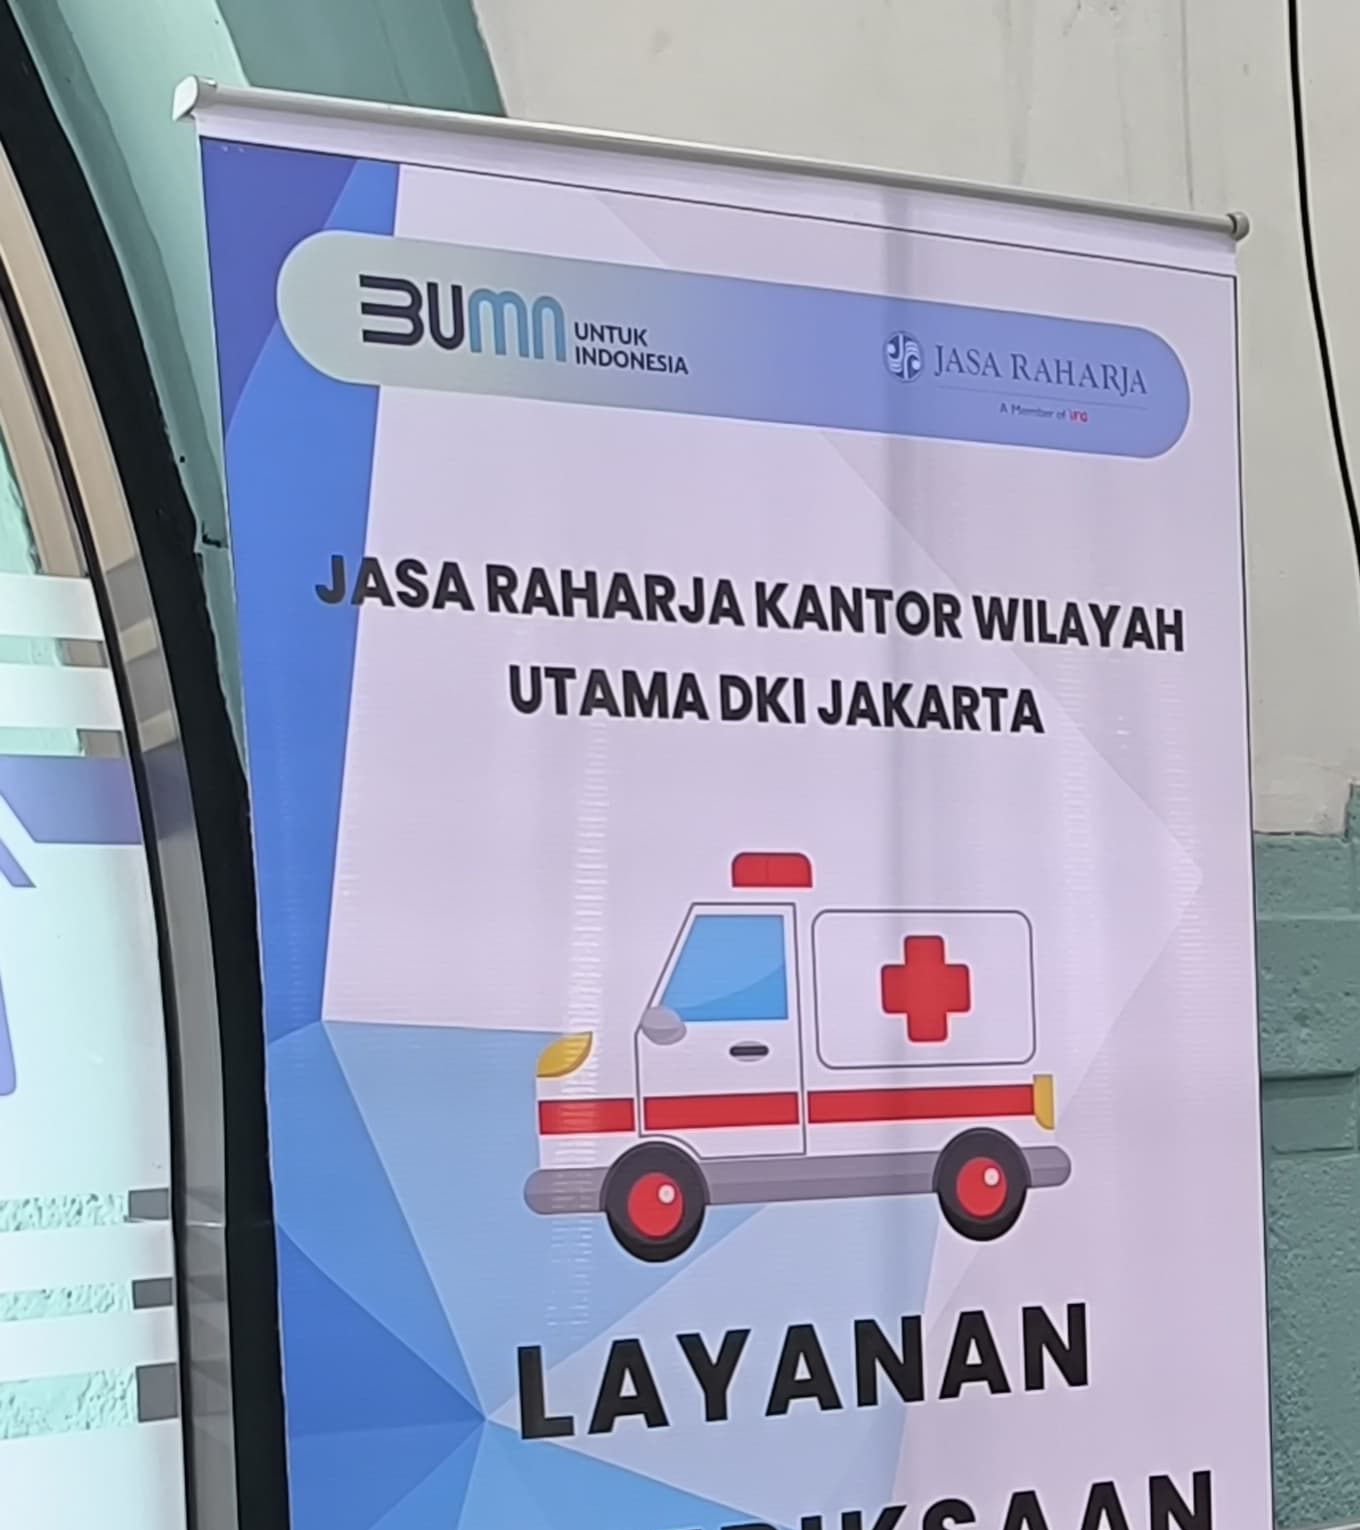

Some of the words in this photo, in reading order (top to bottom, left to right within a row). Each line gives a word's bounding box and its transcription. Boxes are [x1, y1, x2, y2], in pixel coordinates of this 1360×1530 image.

[359, 274, 567, 364] BUMN
[574, 321, 648, 347] UNTUK
[575, 346, 689, 375] INDONESIA
[934, 345, 1001, 378] JASA
[1010, 353, 1148, 397] RAHARJA
[315, 556, 475, 612] JASA
[485, 563, 742, 627] RAHARJA
[754, 580, 963, 640] KANTOR
[972, 594, 1185, 653] WILAYAH
[508, 664, 710, 722] UTAMA
[719, 673, 806, 726] DKI
[816, 678, 1045, 735] JAKARTA
[516, 1302, 1089, 1440] LAYANAN
